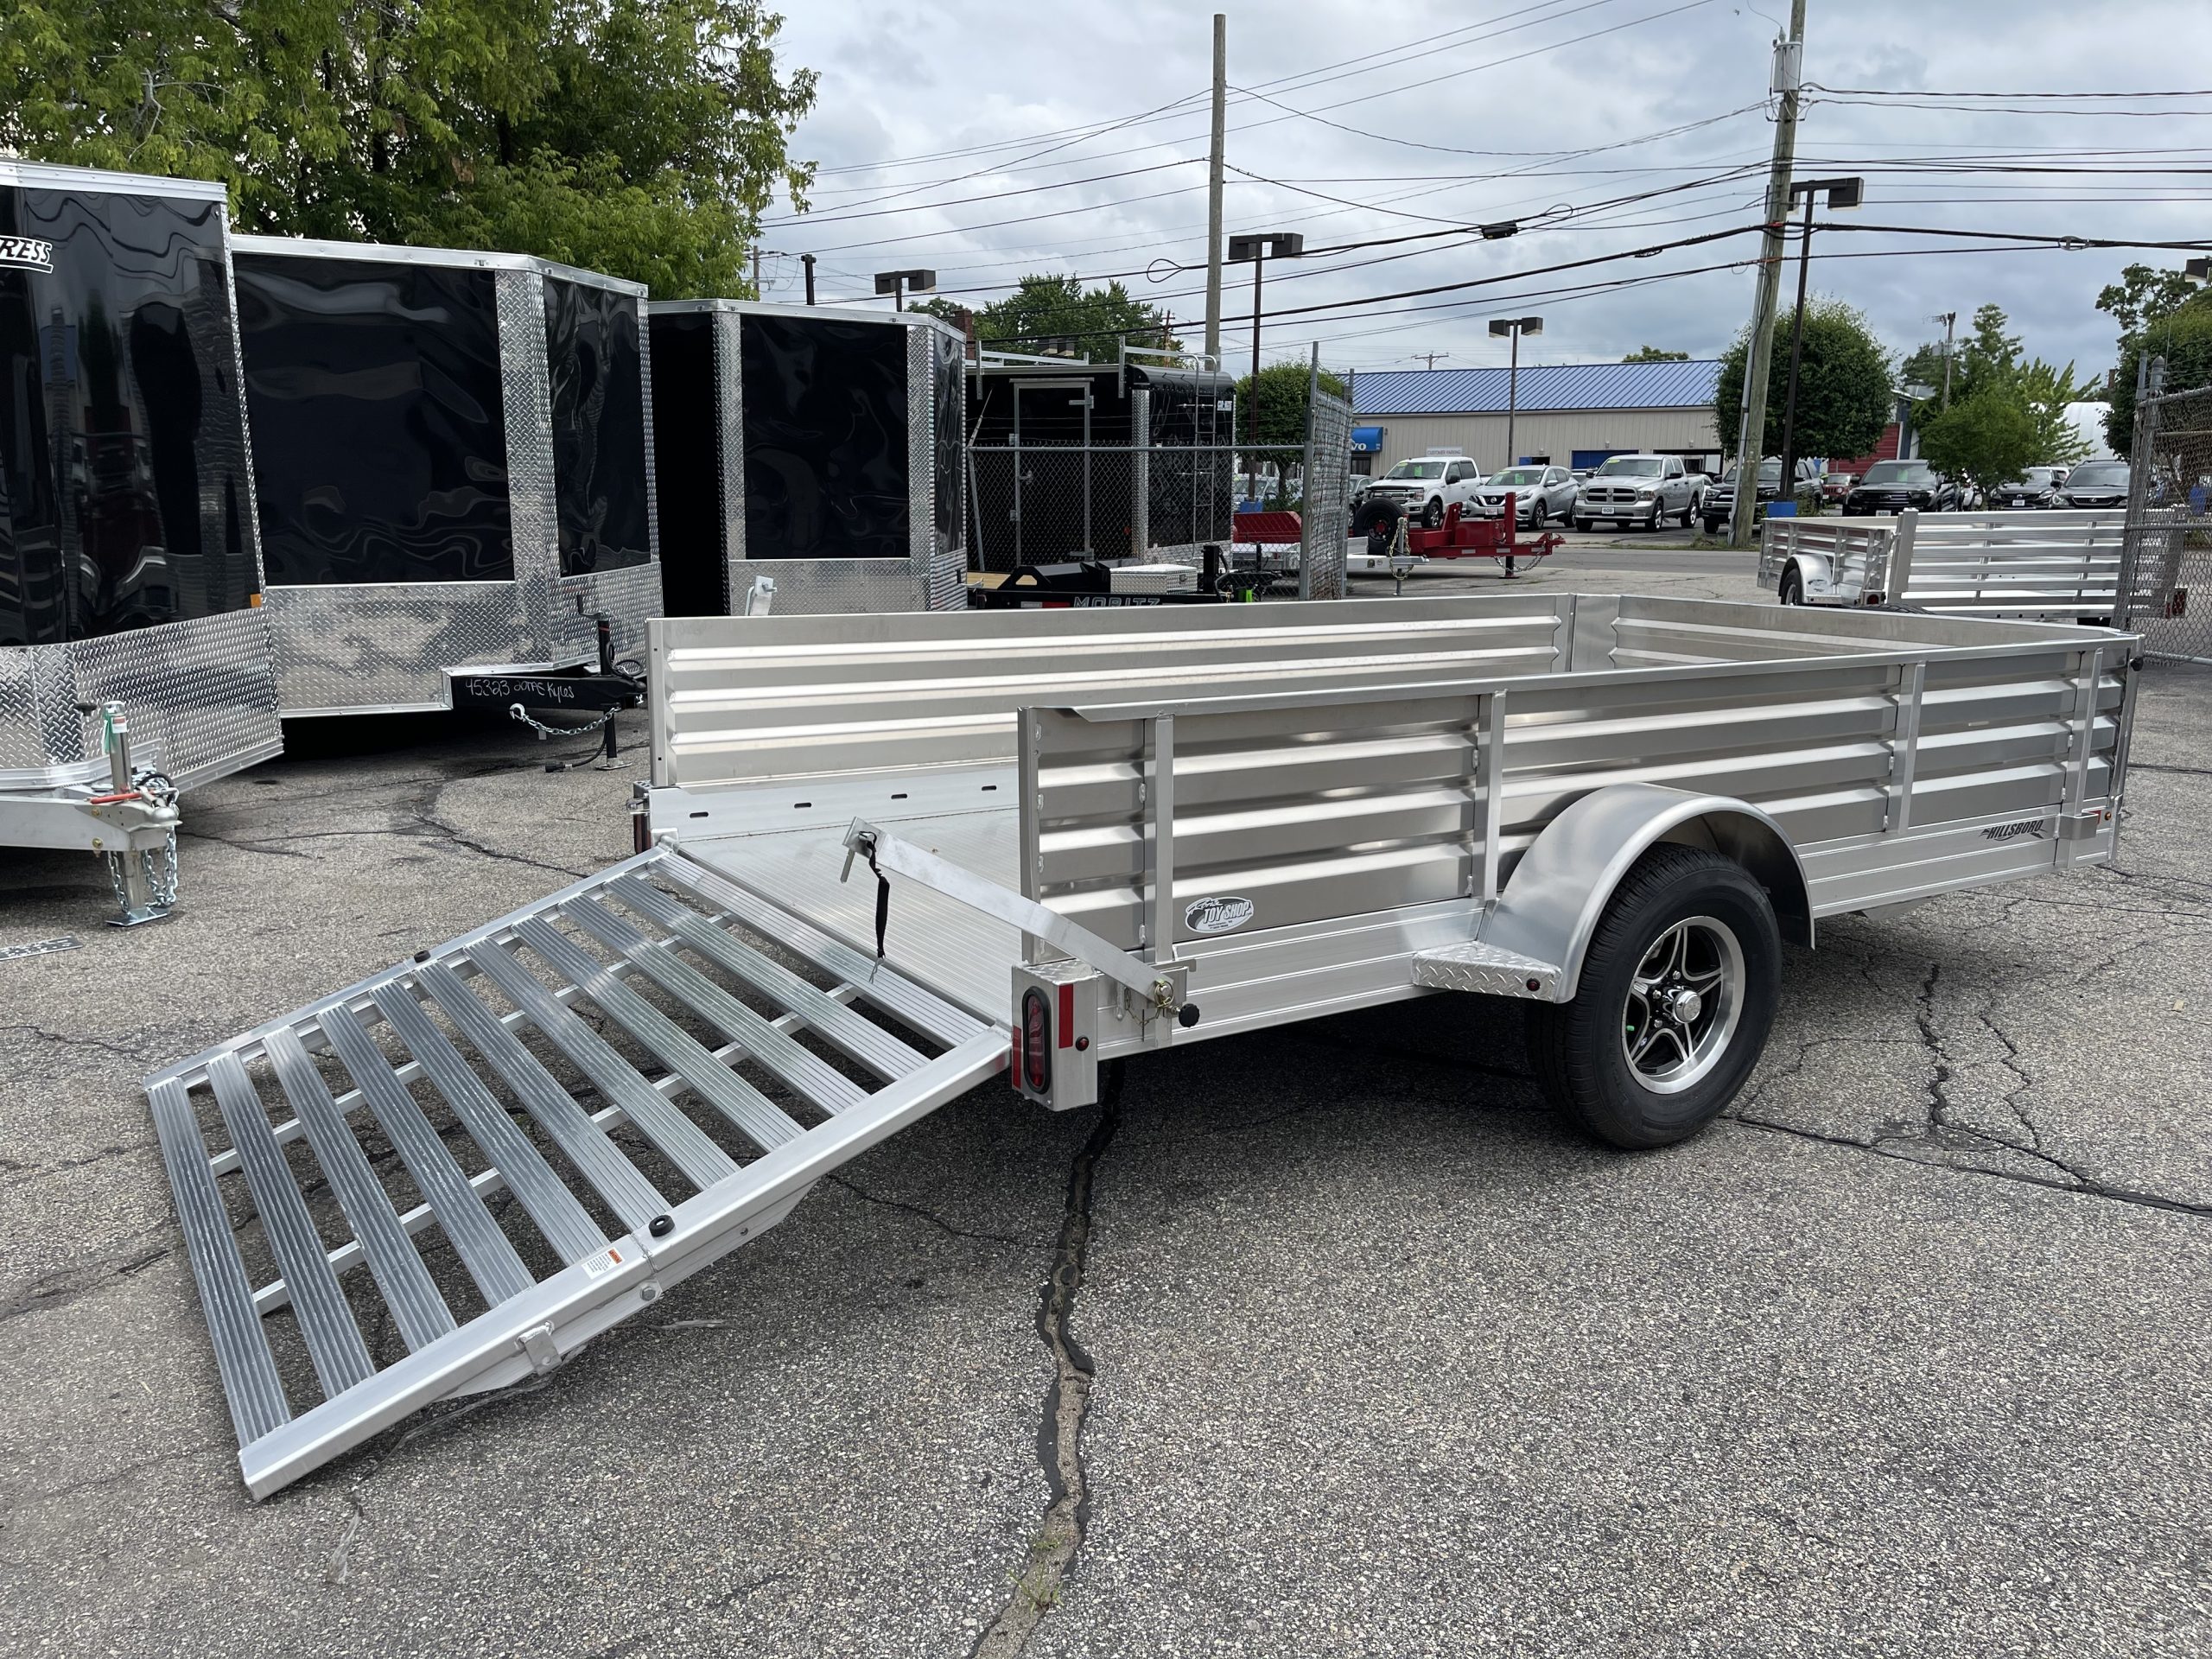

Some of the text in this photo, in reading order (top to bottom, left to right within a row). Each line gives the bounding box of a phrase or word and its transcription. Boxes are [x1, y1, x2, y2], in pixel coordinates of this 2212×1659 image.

[0, 237, 52, 263] RESS
[466, 678, 511, 696] 45323
[1986, 819, 2044, 840] HILLSBORO
[1203, 905, 1224, 924] TOY
[1224, 901, 1250, 920] SHOP
